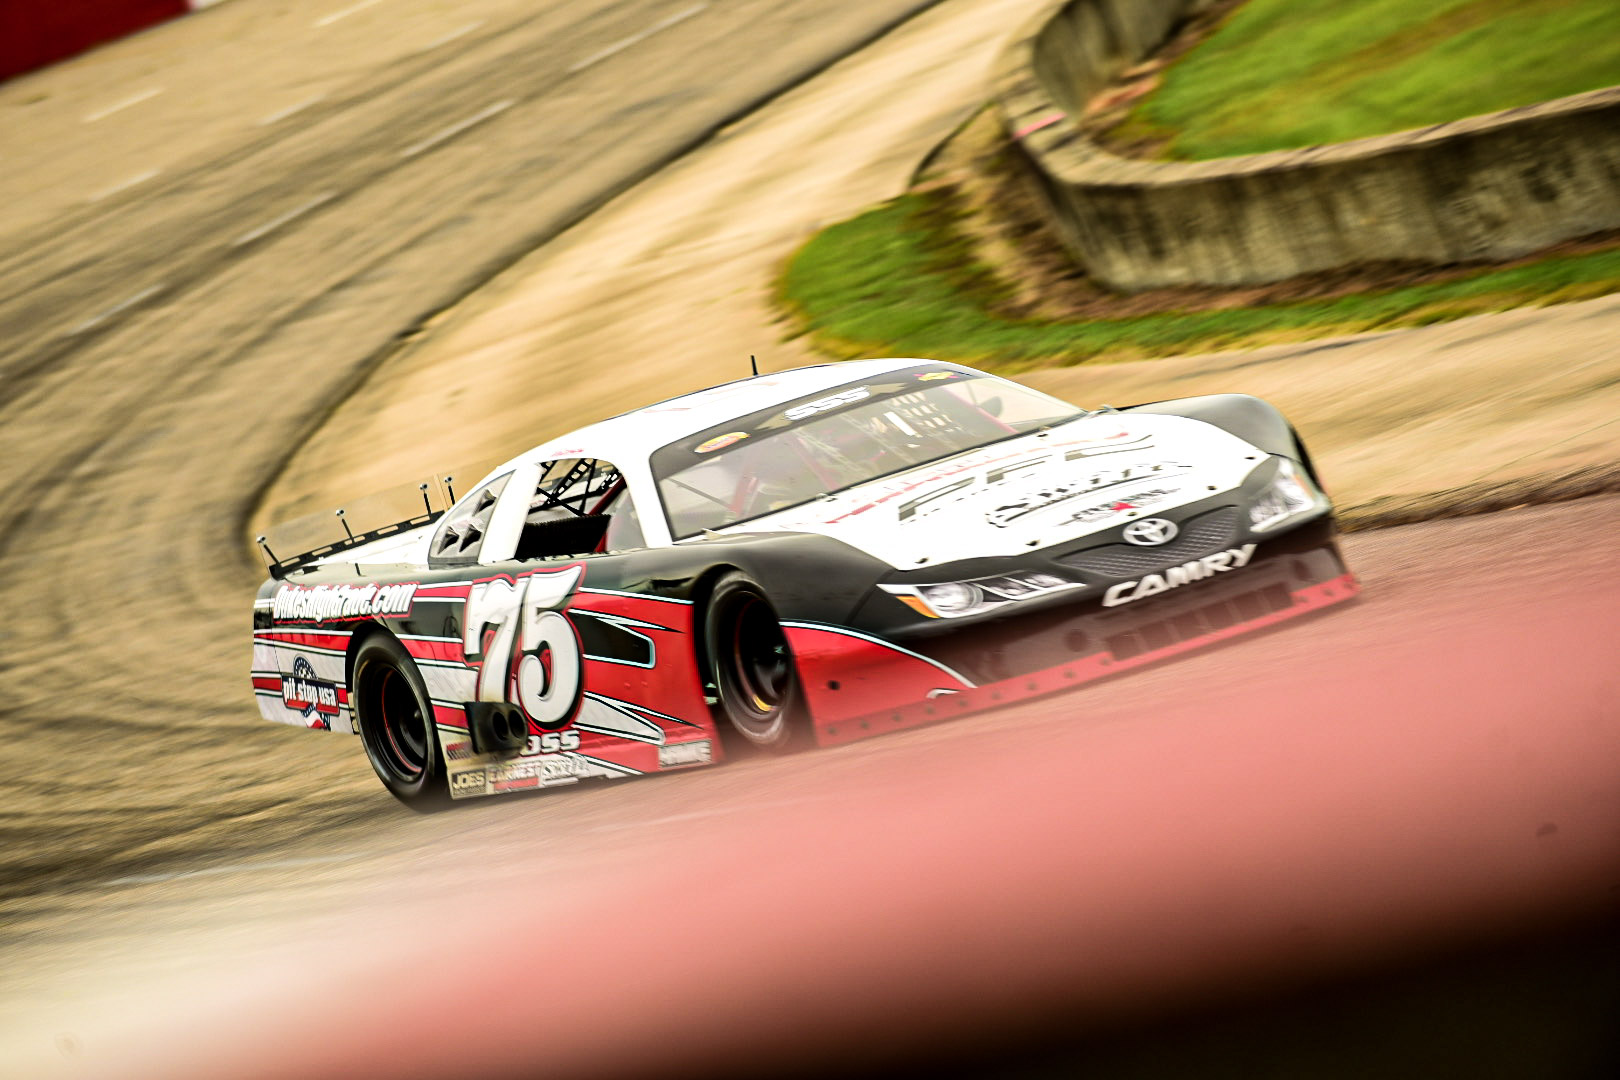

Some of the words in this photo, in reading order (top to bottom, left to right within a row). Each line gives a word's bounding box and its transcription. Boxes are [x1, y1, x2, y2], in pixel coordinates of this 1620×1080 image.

[1102, 543, 1257, 607] CAMRY
[463, 563, 585, 725] 75
[283, 677, 297, 703] pit
[297, 680, 318, 708] stop
[318, 686, 337, 707] usa
[520, 729, 580, 757] OSS
[452, 772, 485, 790] JOES
